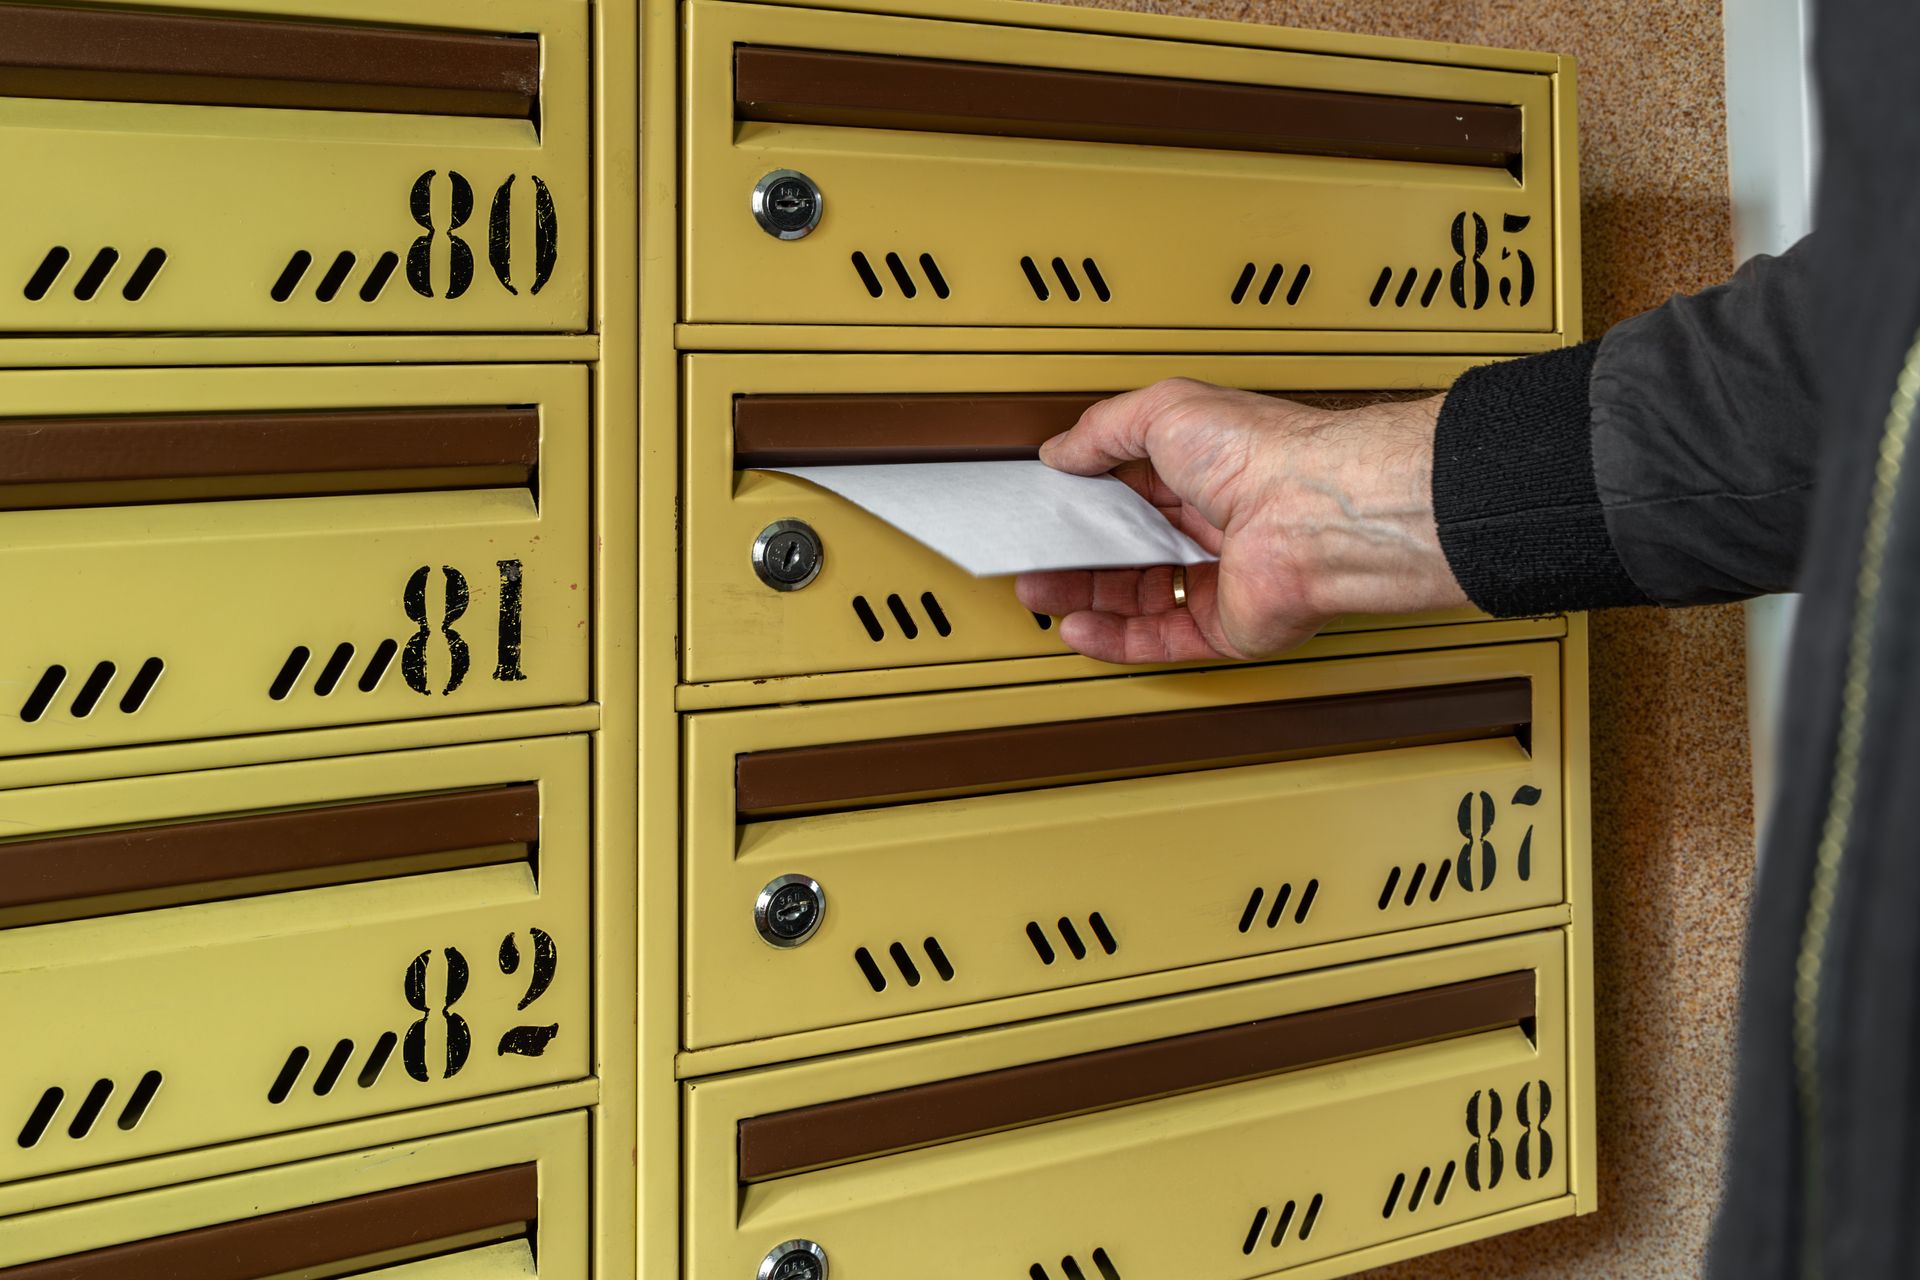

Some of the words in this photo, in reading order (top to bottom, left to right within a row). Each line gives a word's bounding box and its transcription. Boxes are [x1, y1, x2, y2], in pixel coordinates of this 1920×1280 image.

[406, 170, 558, 299] 80
[1450, 211, 1535, 310] 85
[402, 559, 527, 697] 81
[1457, 785, 1542, 892] 87
[403, 928, 559, 1082] 82
[1466, 1080, 1553, 1191] 88
